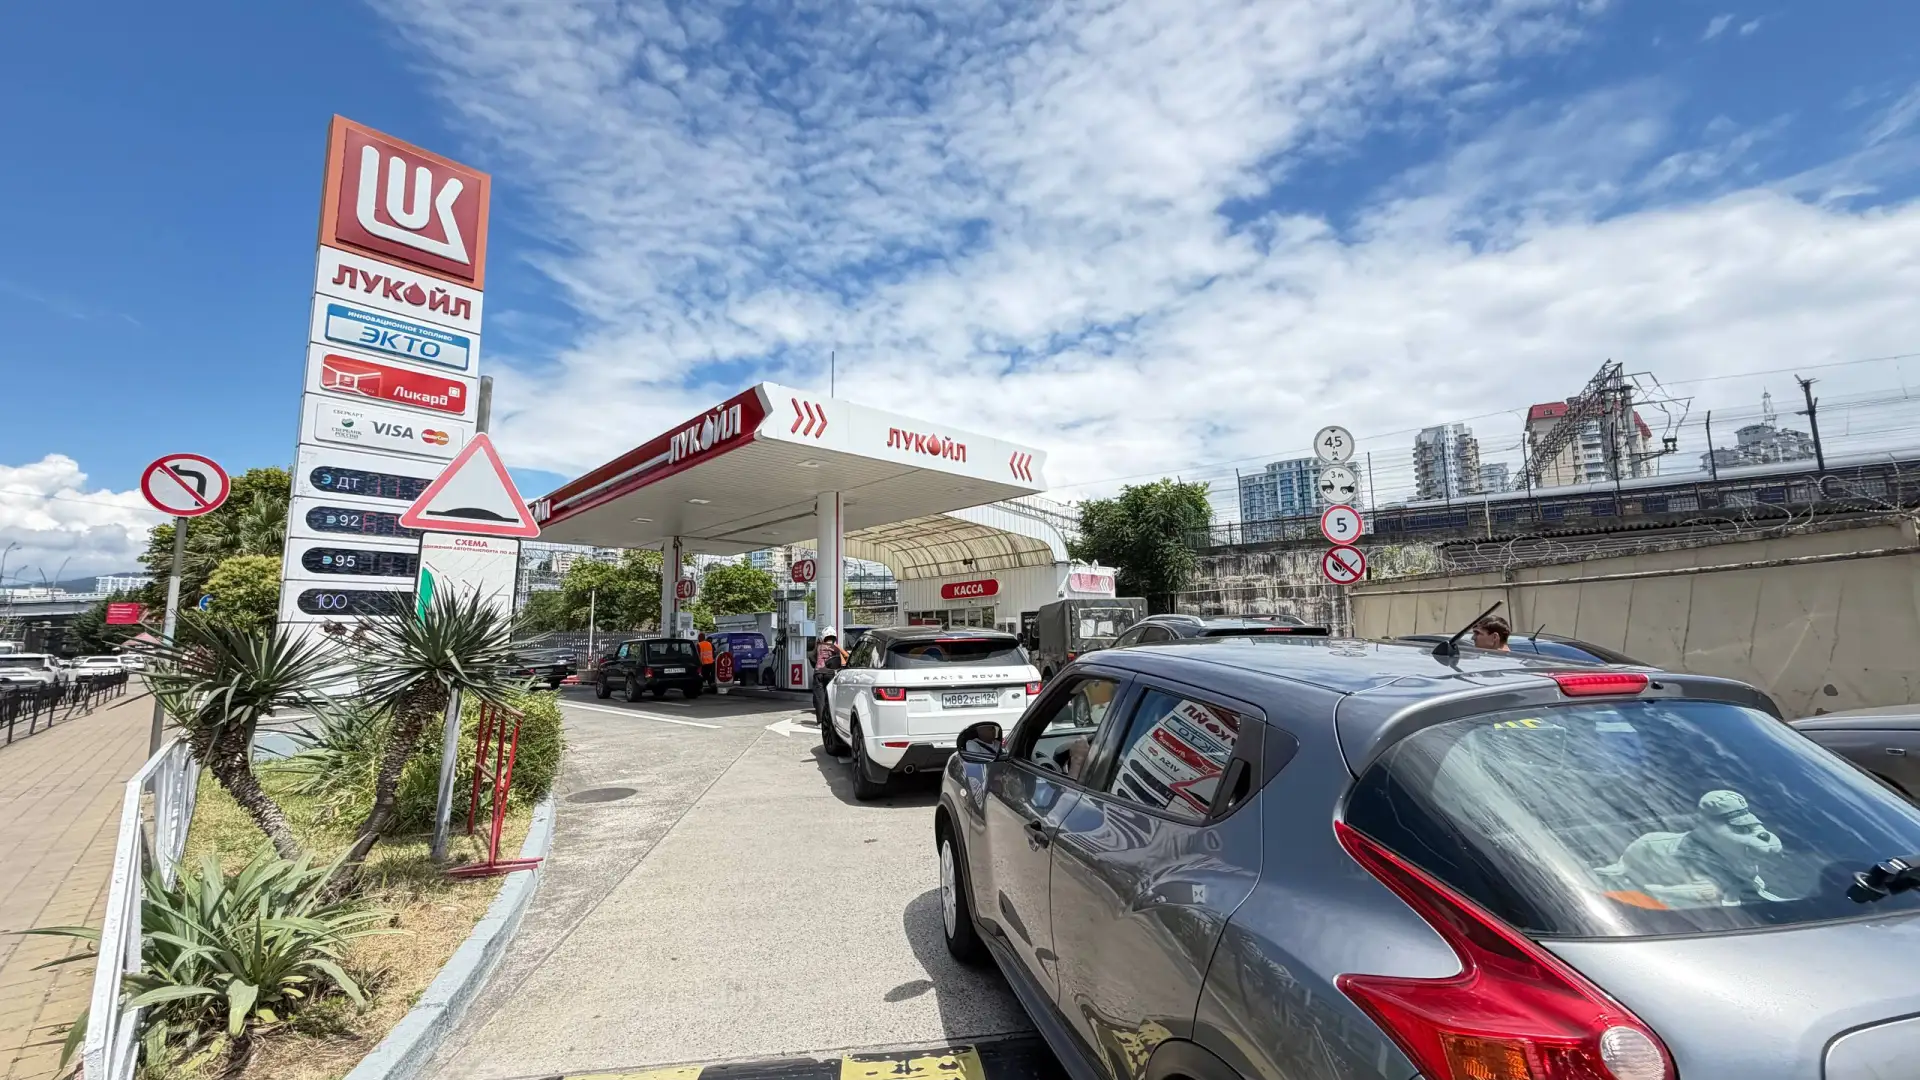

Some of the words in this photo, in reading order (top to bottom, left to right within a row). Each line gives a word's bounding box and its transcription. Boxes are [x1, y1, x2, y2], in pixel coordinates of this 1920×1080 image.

[332, 263, 472, 320] ЛУКОЙЛ
[347, 311, 417, 333] ИННОВАЦИОННОЕ
[419, 328, 453, 341] ТОПЛИВО
[359, 325, 441, 358] ЭКТО
[370, 420, 414, 439] VISA
[668, 404, 742, 465] ЛУКОЙЛ
[887, 427, 967, 463] ЛУКОЙЛ
[336, 476, 361, 490] ДТ
[339, 514, 359, 527] 92
[1336, 517, 1348, 533] 5
[455, 538, 488, 548] СХЕМА
[335, 555, 356, 567] 95
[953, 583, 984, 596] КАССА
[315, 593, 348, 609] 100
[794, 667, 800, 682] 2
